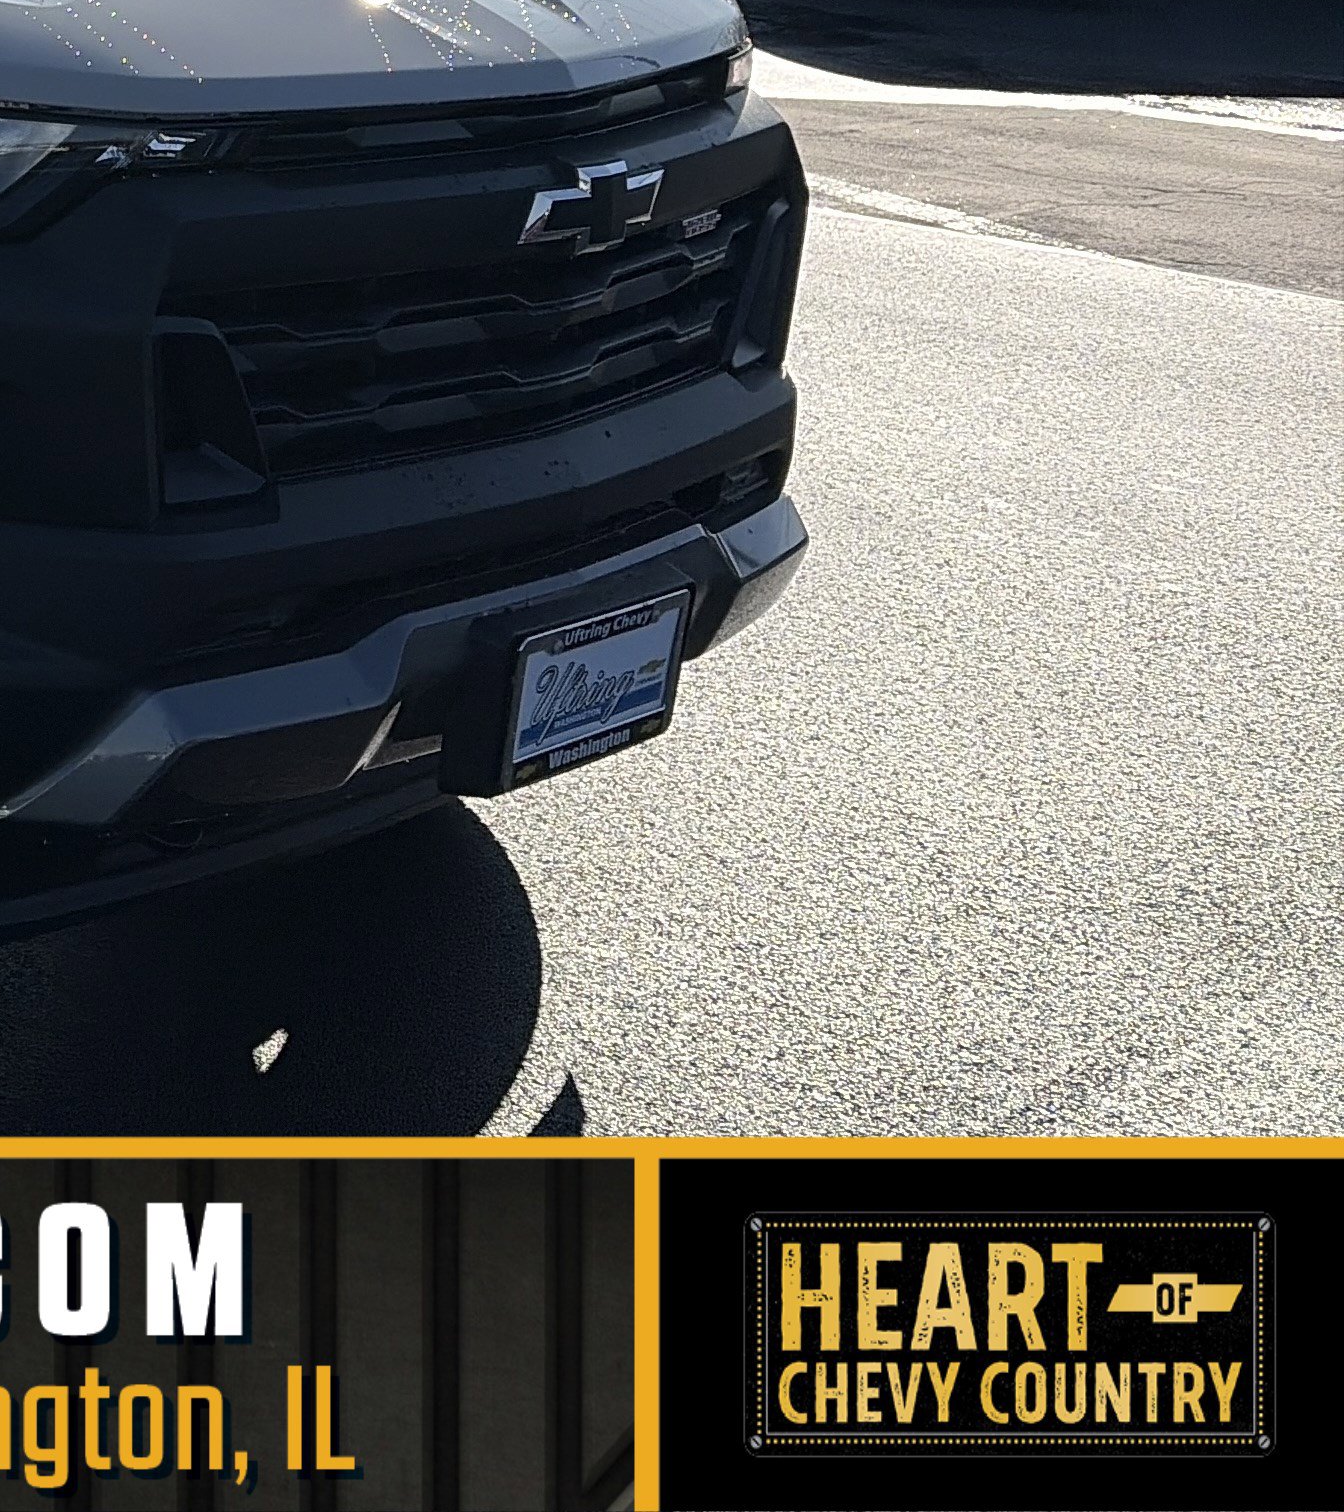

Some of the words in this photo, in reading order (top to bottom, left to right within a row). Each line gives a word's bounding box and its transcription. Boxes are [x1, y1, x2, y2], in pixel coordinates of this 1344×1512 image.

[564, 621, 612, 647] Uftring
[613, 609, 654, 631] Chevy
[530, 661, 636, 746] Uftring
[549, 728, 631, 770] Washington
